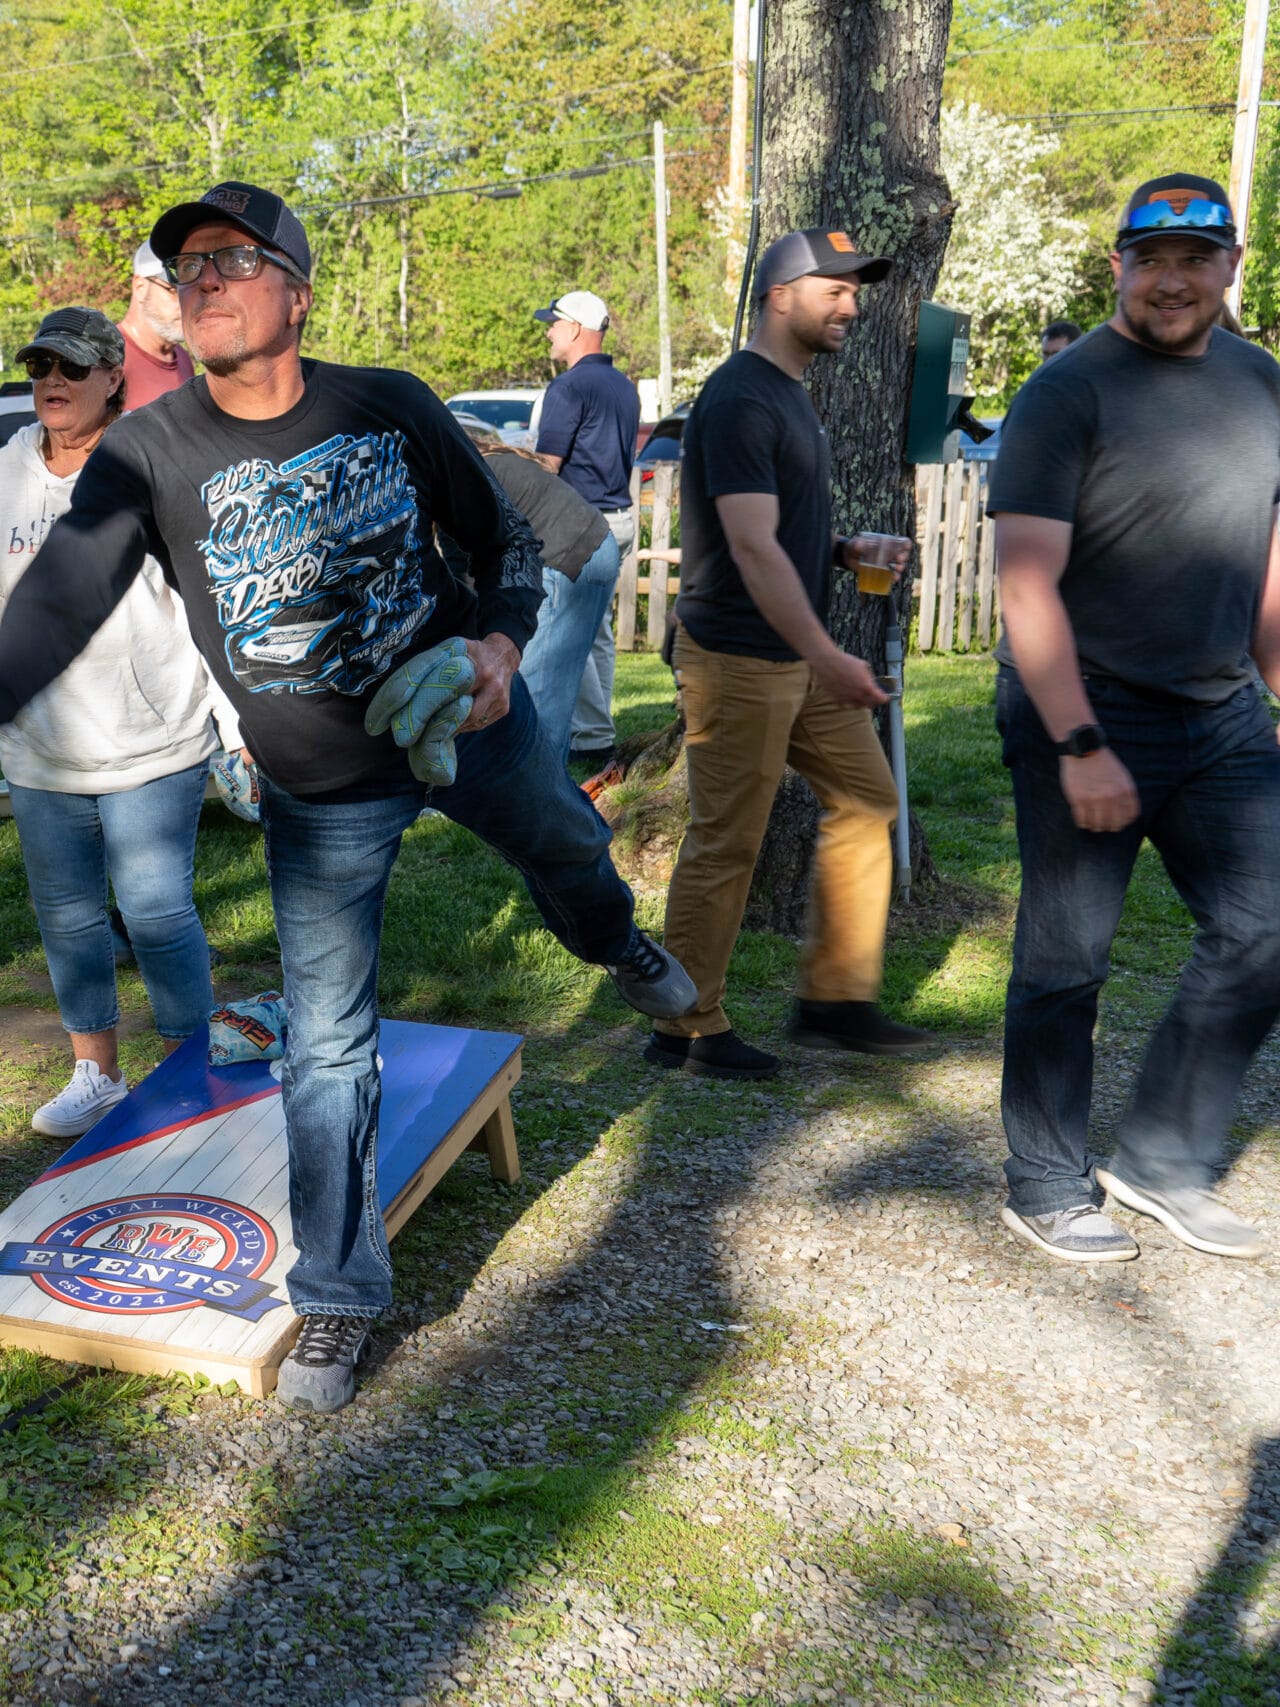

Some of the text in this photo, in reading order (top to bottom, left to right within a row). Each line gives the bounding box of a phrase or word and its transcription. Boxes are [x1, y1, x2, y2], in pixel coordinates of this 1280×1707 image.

[308, 435, 343, 460] ANNUAL
[210, 458, 265, 503] 2025
[207, 431, 408, 579] Snowball
[226, 549, 328, 626] DERBY
[349, 647, 370, 662] FIVE
[87, 1201, 261, 1250] REAL WICKED
[100, 1222, 220, 1262] RWE
[20, 1249, 241, 1298] EVENTS
[58, 1279, 166, 1306] est. 2024
